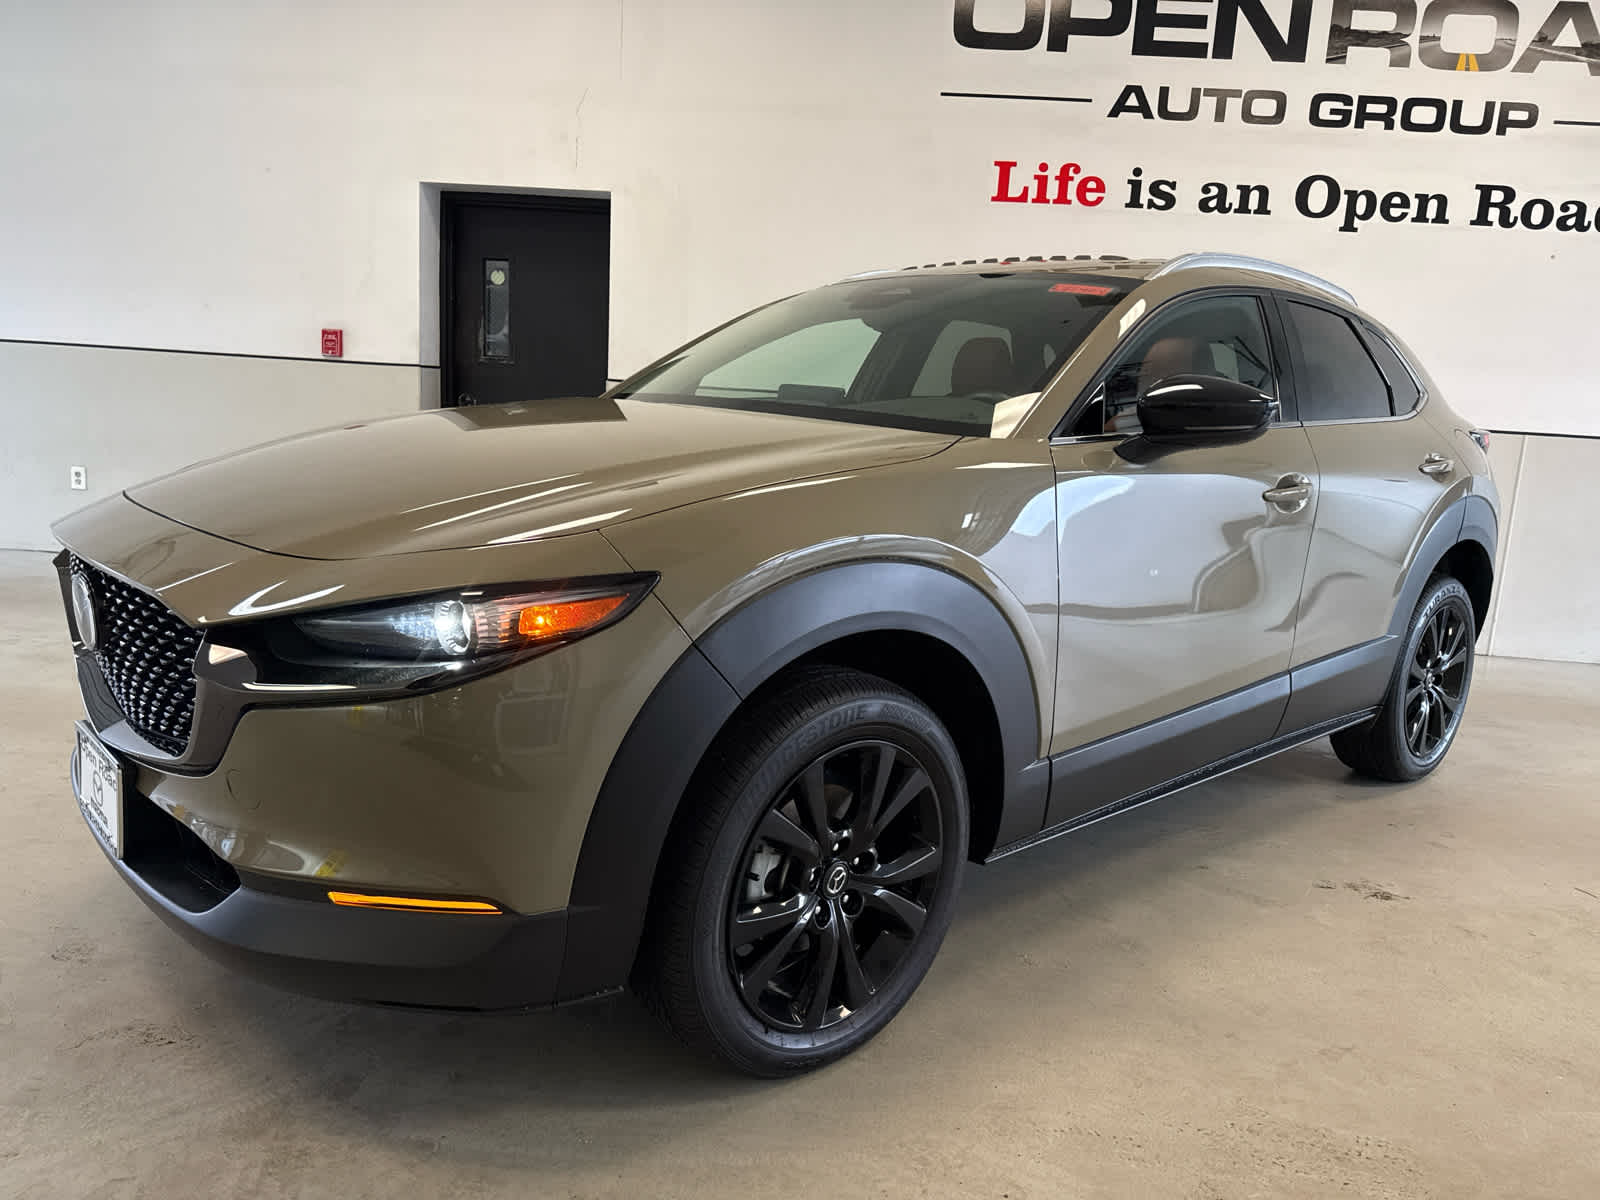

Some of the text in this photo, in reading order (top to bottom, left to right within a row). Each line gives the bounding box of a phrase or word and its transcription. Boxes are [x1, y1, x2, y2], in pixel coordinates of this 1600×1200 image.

[953, 0, 1313, 63] OPEN
[1107, 85, 1539, 136] AUTO GROUP
[991, 160, 1600, 232] Life is an Open Roa
